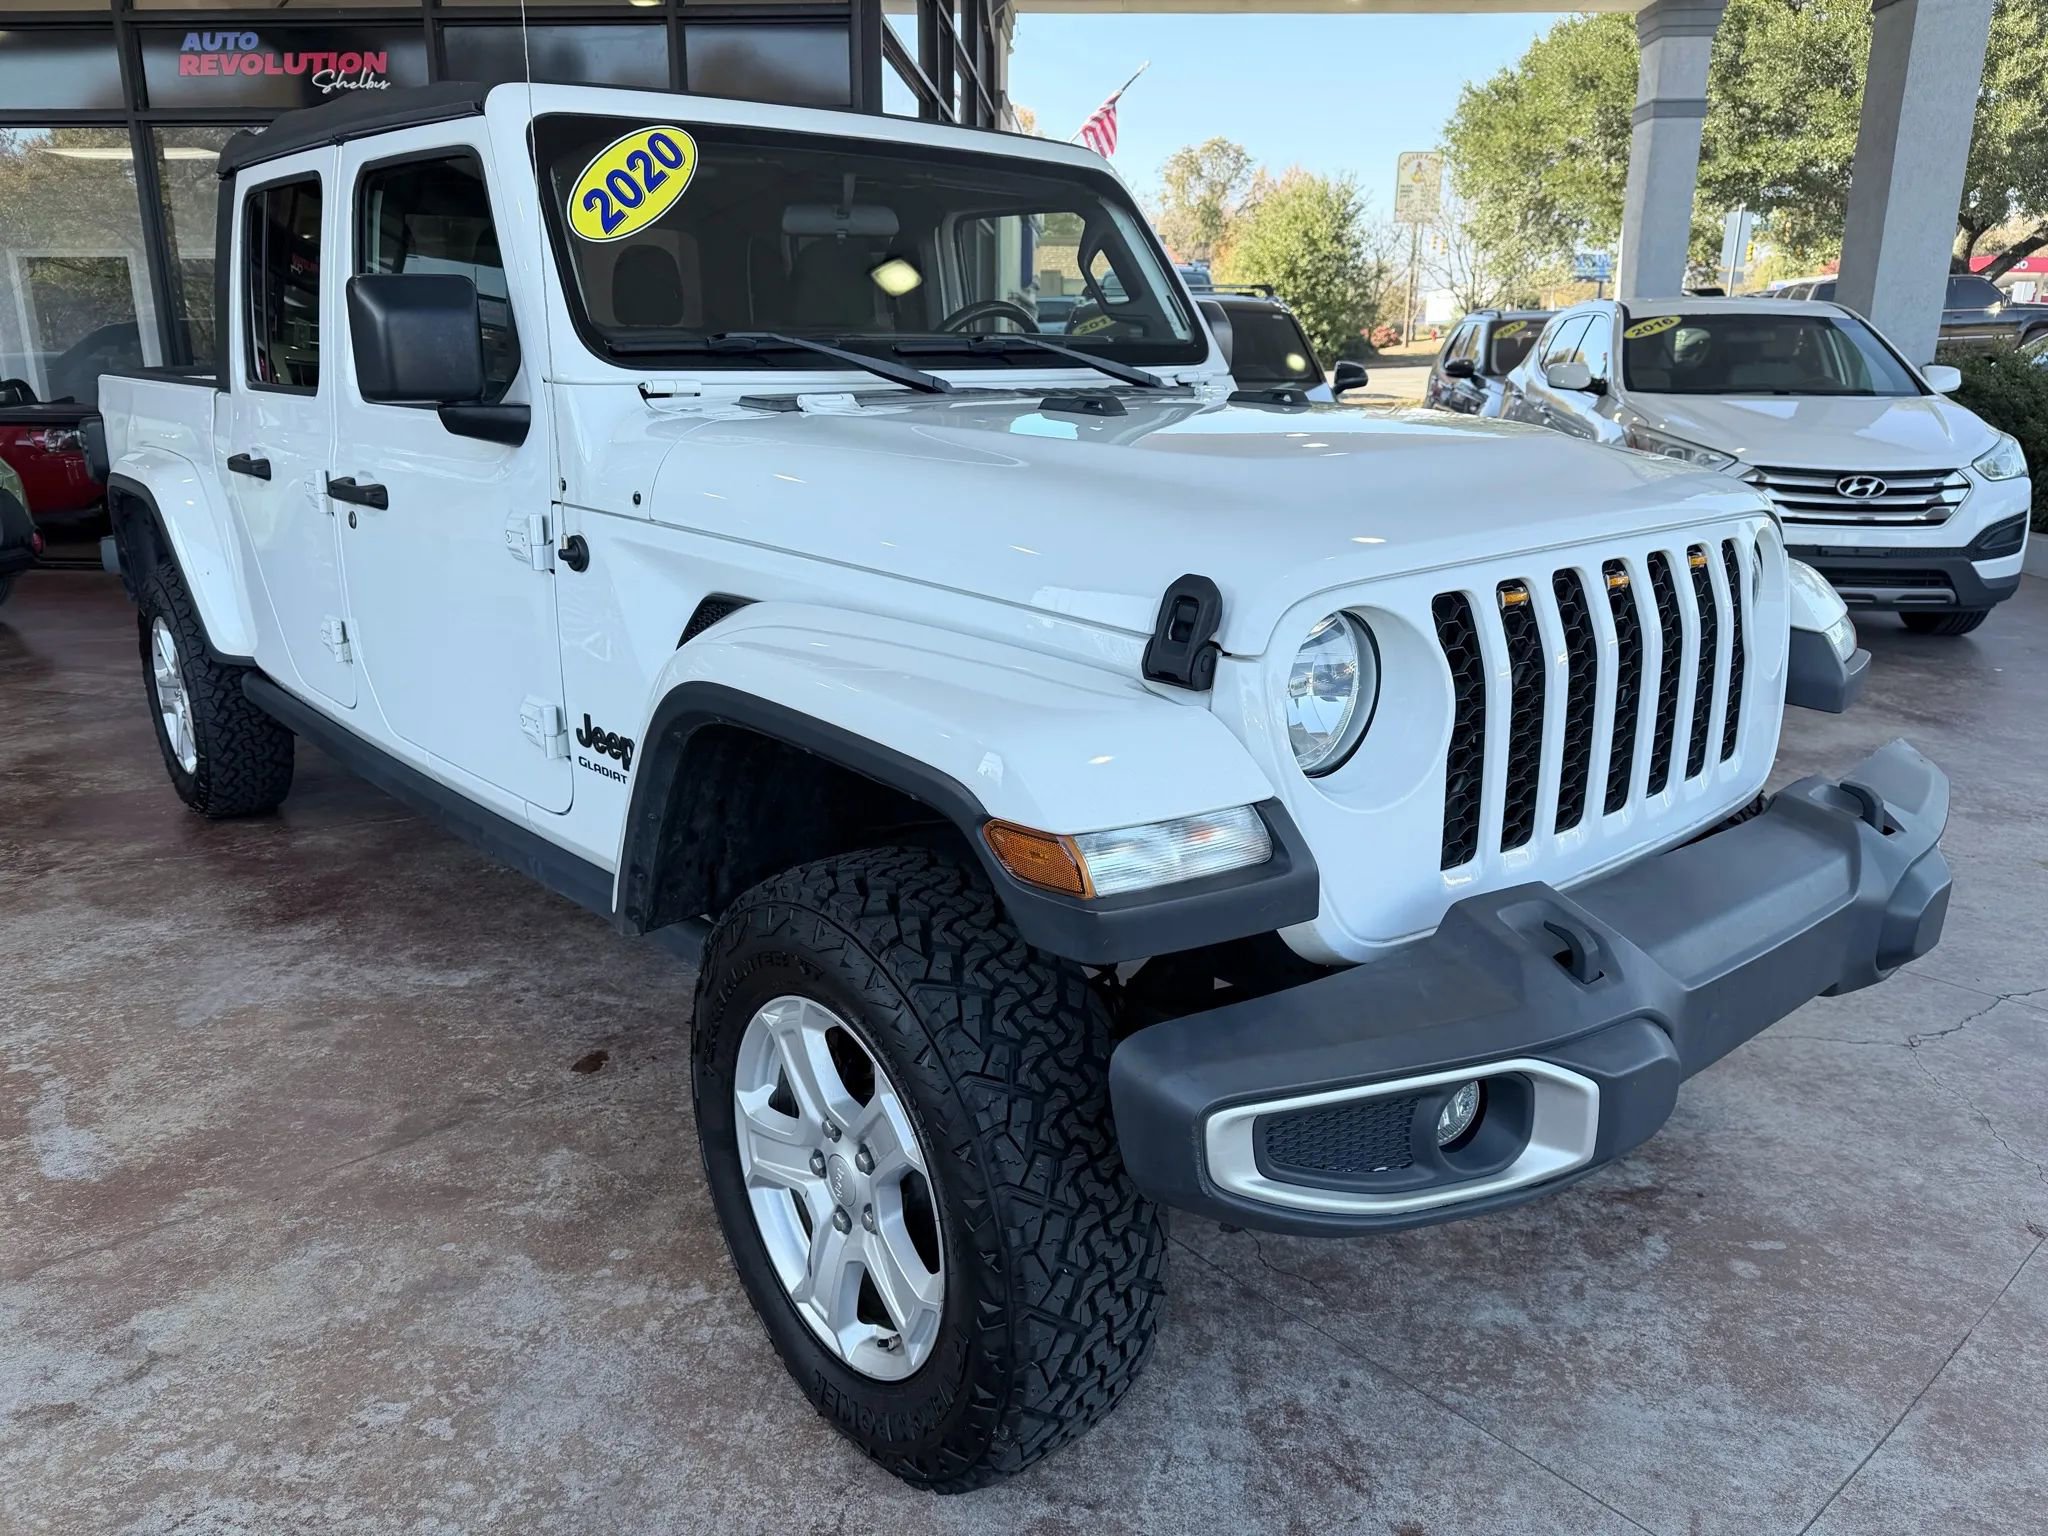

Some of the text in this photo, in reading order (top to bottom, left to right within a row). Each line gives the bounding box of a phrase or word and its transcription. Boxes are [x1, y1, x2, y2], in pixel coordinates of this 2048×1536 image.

[181, 32, 259, 51] AUTO
[178, 52, 388, 76] REVOLUTION
[583, 133, 685, 235] 2020
[1080, 318, 1109, 334] 201
[576, 713, 635, 772] Jeep
[578, 756, 628, 784] GLADIAT
